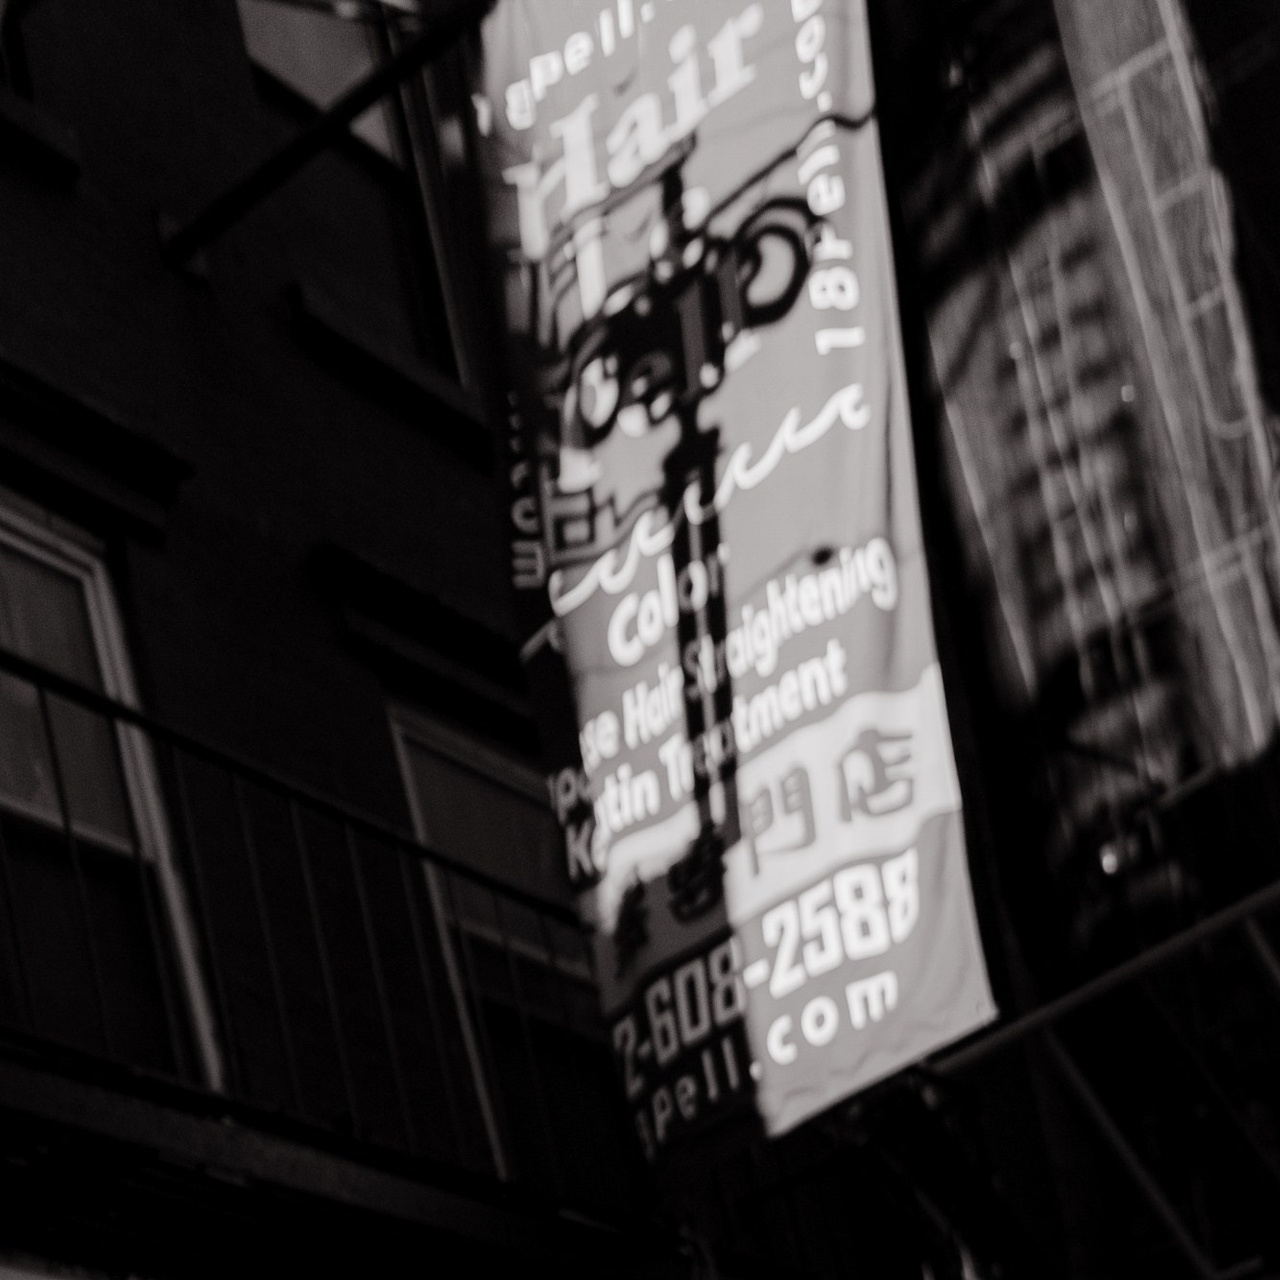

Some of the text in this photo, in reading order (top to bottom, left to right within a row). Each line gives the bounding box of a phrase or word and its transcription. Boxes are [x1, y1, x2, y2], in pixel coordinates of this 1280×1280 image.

[503, 4, 764, 262] Hair
[622, 662, 686, 750] Hair
[684, 536, 898, 702] Straightening
